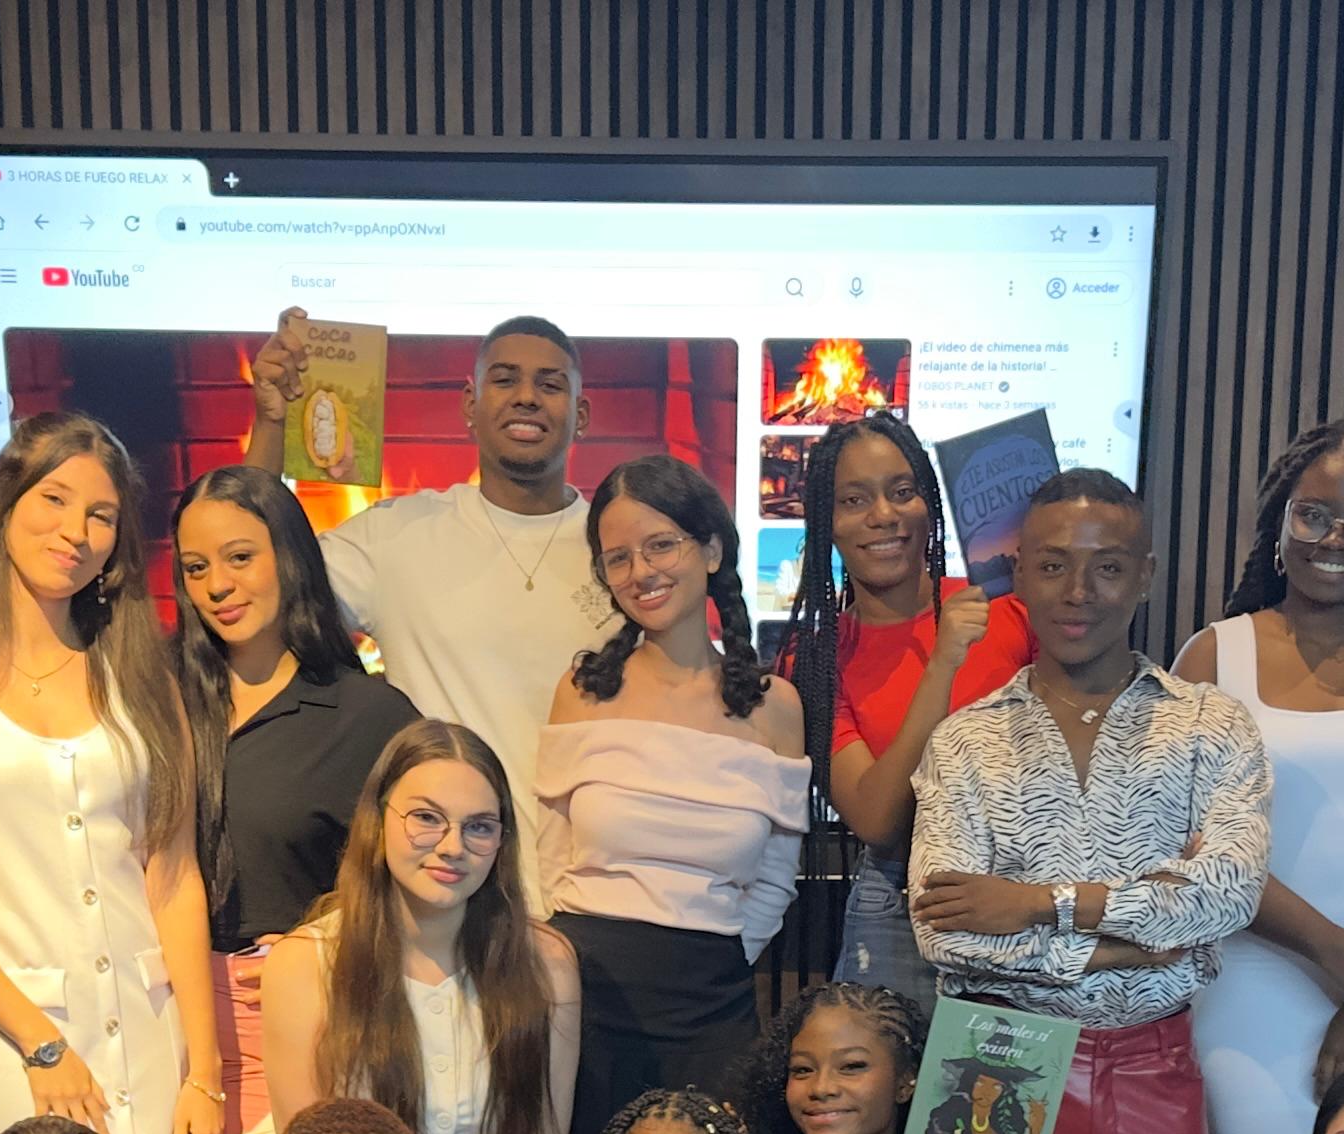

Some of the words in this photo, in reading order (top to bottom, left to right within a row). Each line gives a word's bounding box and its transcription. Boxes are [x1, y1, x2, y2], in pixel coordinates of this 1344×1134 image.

[7, 169, 16, 182] 3
[19, 170, 62, 183] HORAS
[65, 171, 81, 183] DE
[84, 171, 126, 184] FUEGO
[71, 269, 129, 287] YouTube
[291, 275, 337, 289] Buscar
[1072, 282, 1120, 294] Acceder
[970, 342, 984, 353] de
[986, 342, 1042, 353] chimenea
[1045, 342, 1069, 353] más
[918, 361, 968, 374] relajante
[971, 361, 985, 371] de
[987, 361, 998, 371] la
[939, 401, 969, 410] vistas
[978, 401, 1002, 410] hace
[1062, 437, 1087, 449] café
[965, 1013, 995, 1032] Los
[995, 1023, 1035, 1040] males
[975, 1039, 1024, 1059] existen
